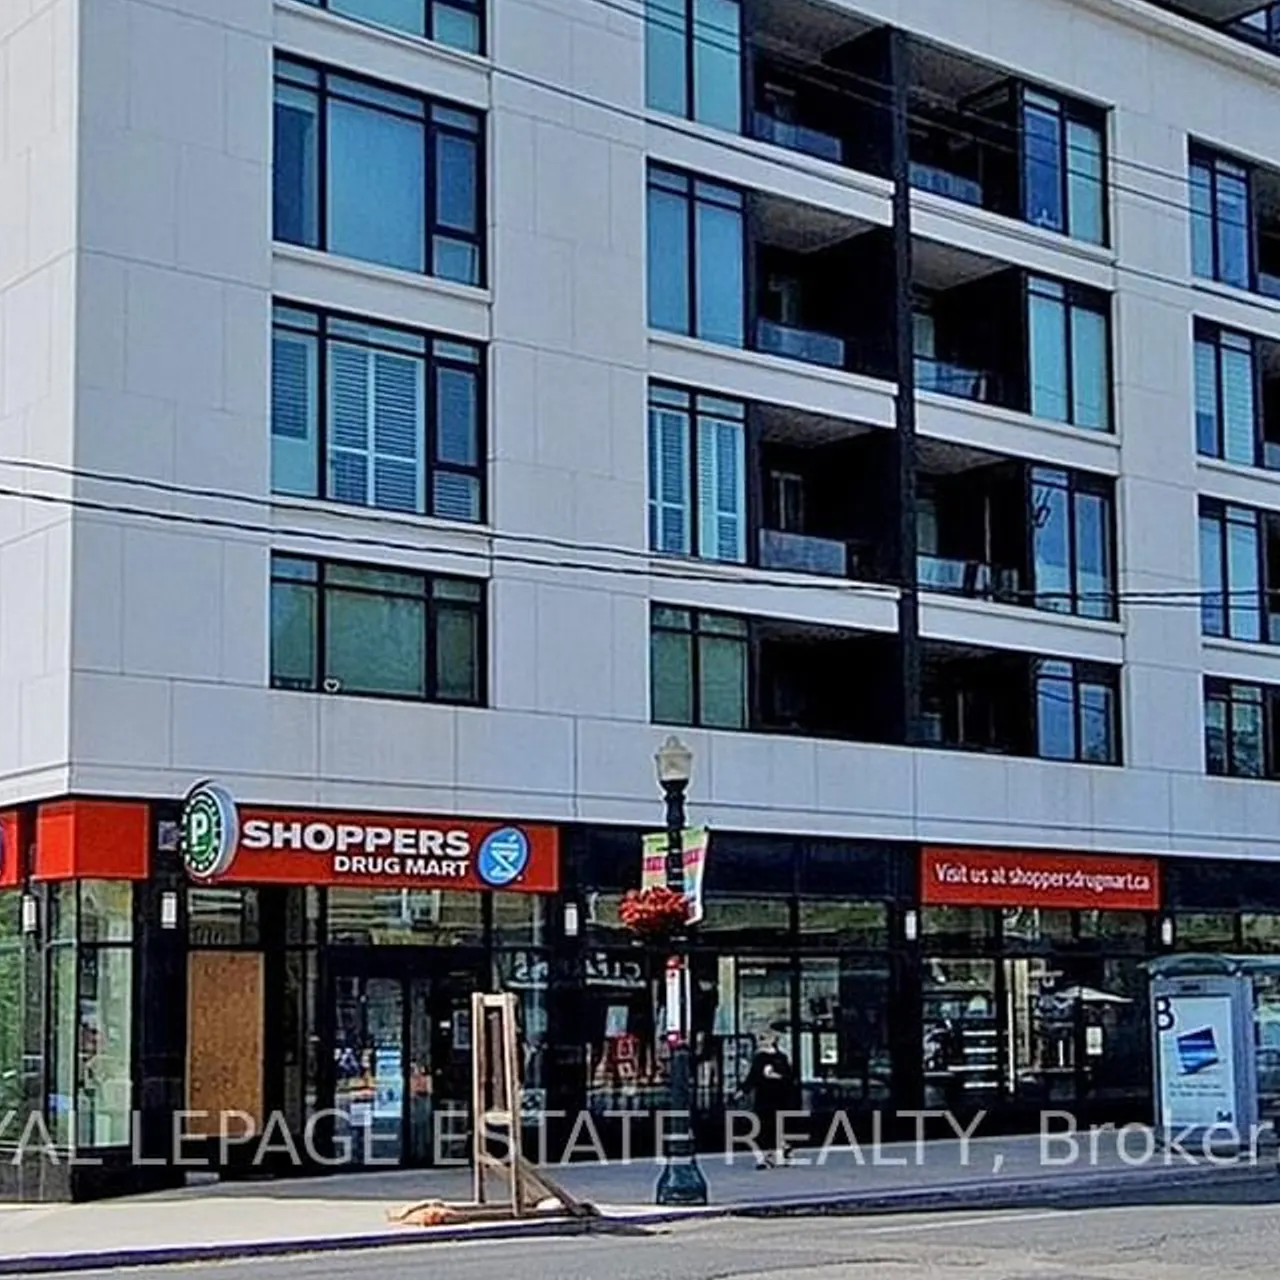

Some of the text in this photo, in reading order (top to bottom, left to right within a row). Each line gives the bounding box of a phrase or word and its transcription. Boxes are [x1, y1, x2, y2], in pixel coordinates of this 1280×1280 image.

[240, 820, 471, 858] SHOPPERS
[334, 856, 471, 877] DRUG MART
[935, 863, 968, 884] Visit
[970, 871, 989, 884] us
[991, 869, 1006, 884] at
